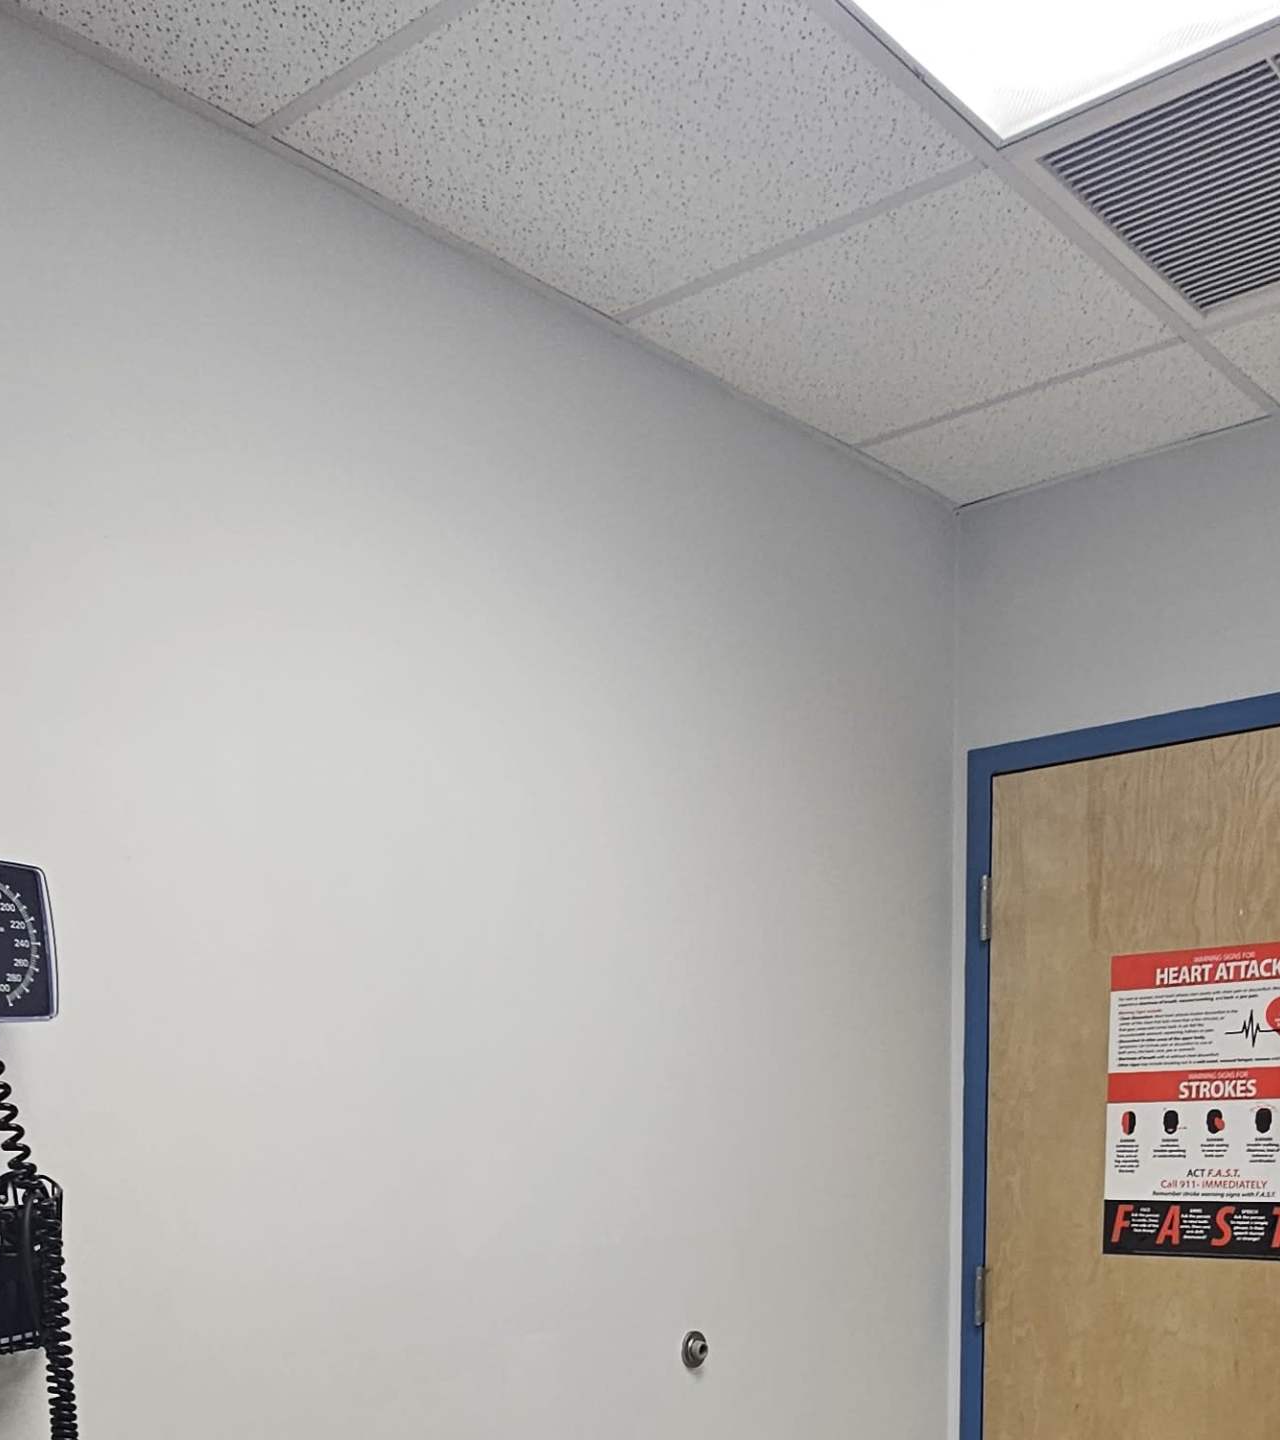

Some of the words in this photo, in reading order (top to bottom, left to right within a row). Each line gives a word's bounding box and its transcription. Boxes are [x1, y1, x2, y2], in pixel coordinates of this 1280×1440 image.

[0, 902, 16, 912] 200
[10, 920, 26, 929] 220
[14, 939, 30, 948] 240
[1155, 964, 1213, 985] HEART
[1178, 1079, 1257, 1099] STROKES
[1186, 1169, 1205, 1177] ACT
[1207, 1168, 1240, 1178] F.A.S.T.
[1160, 1180, 1177, 1189] Call
[1201, 1180, 1268, 1189] IMMEDIATELY
[1111, 1204, 1134, 1242] F
[1156, 1205, 1180, 1244] A
[1211, 1205, 1236, 1246] S
